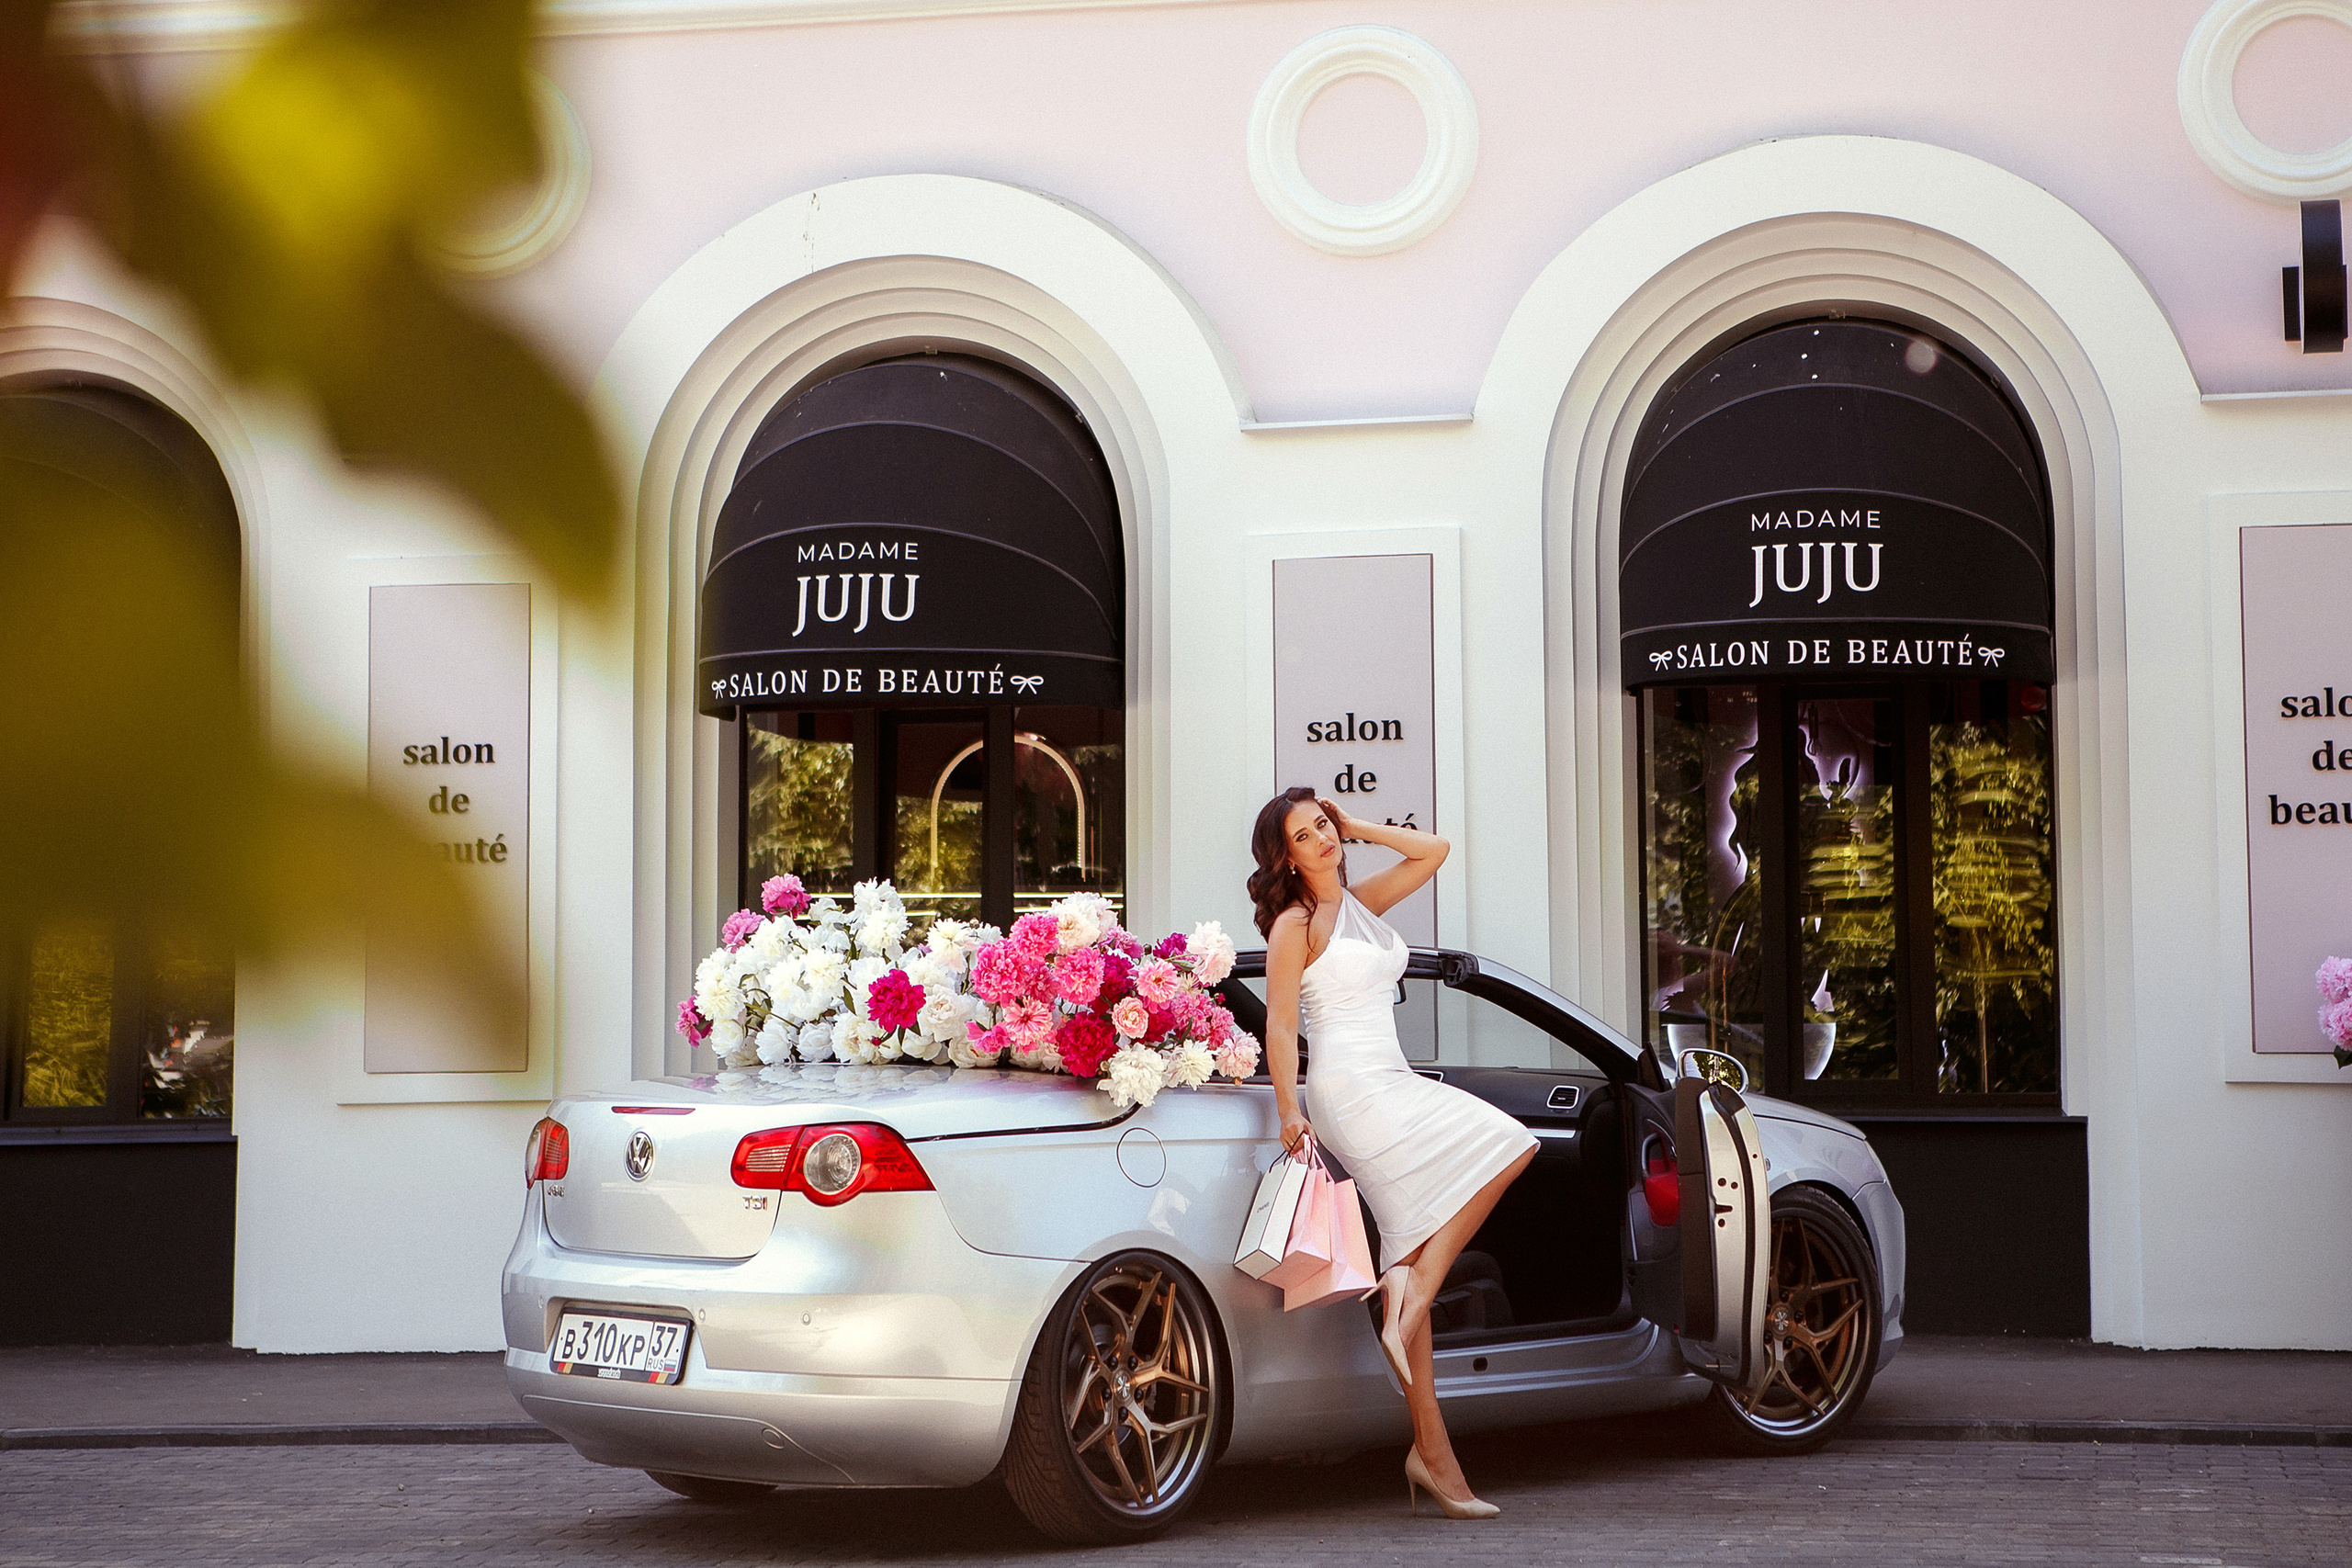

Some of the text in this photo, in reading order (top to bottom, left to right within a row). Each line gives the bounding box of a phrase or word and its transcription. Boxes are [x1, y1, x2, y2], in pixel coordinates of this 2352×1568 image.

[1750, 509, 1882, 532] MADAME
[797, 541, 919, 563] MADAME
[1748, 542, 1884, 608] JUJU
[791, 572, 920, 637] JUJU
[1676, 633, 1973, 670] SALON DE BEAUTÉ
[729, 663, 1005, 698] SALON DE BEAUTÉ
[1306, 712, 1404, 743] salon
[402, 736, 496, 765] salon
[2311, 739, 2352, 771] de
[1333, 763, 1377, 794] de
[427, 785, 469, 814] de
[432, 833, 507, 863] auté
[651, 1325, 678, 1358] 37
[646, 1358, 664, 1371] RUS
